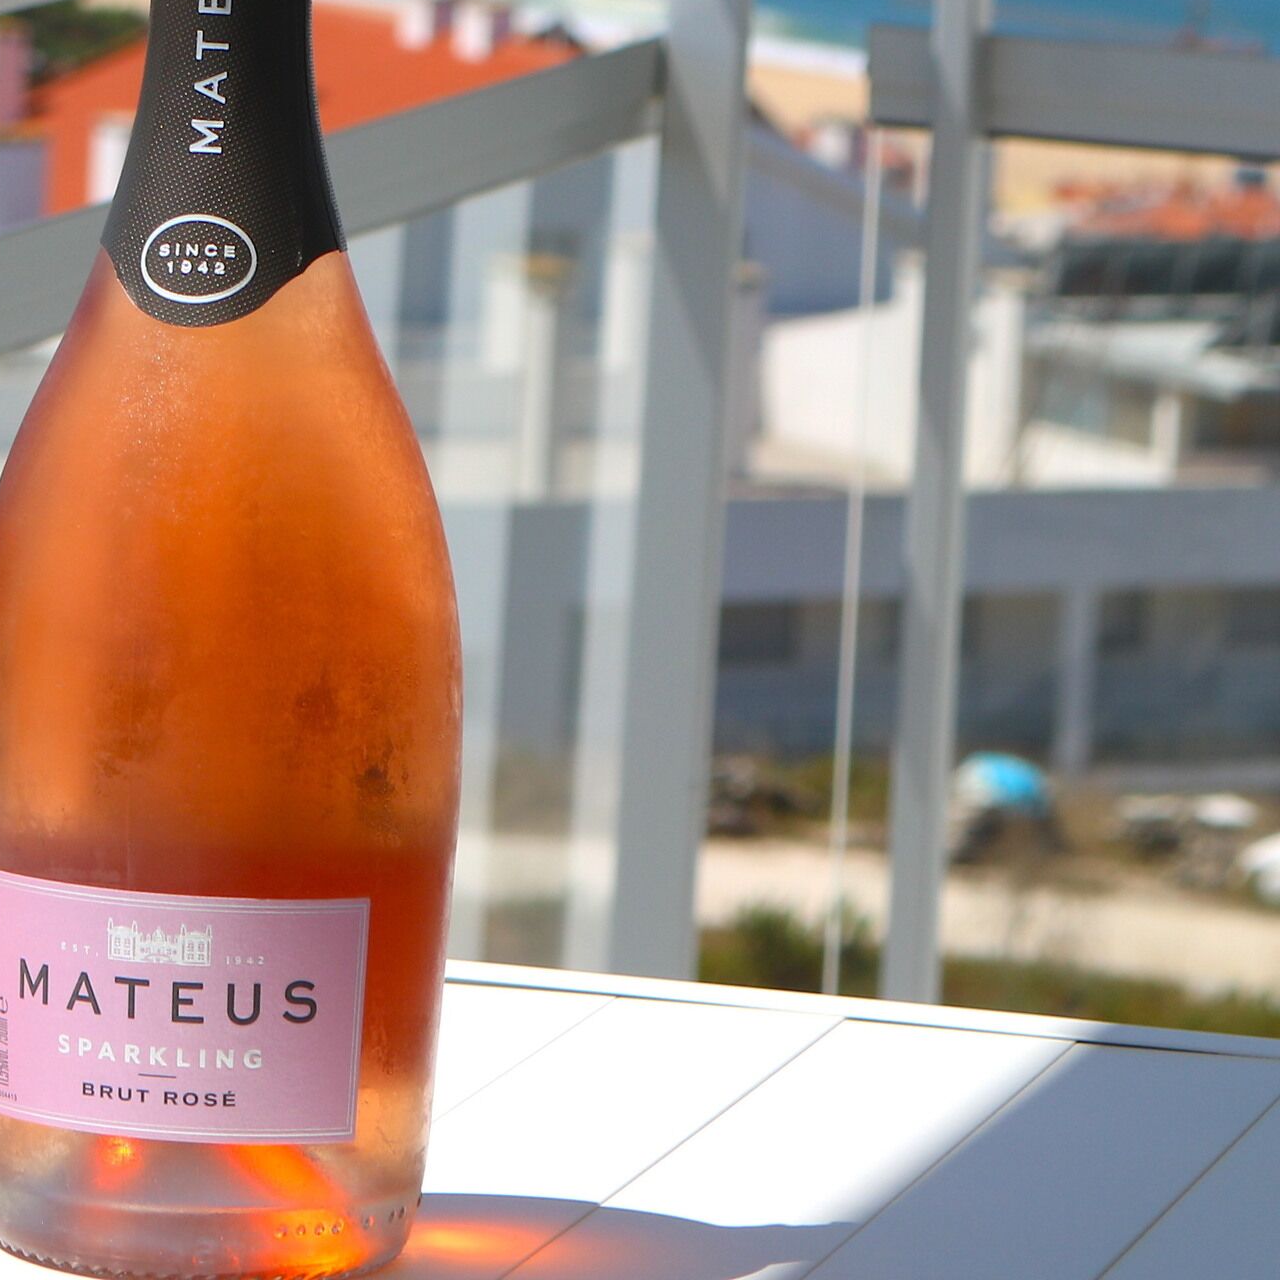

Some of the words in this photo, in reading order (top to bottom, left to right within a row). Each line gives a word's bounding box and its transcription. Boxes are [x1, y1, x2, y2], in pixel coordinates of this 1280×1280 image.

[159, 243, 236, 258] SINCE
[167, 260, 225, 275] 1942
[225, 955, 265, 966] 1942
[18, 958, 318, 1025] MATEUS
[57, 1034, 263, 1069] SPARKLING
[82, 1082, 149, 1103] BRUT
[163, 1090, 236, 1107] ROSÉ
